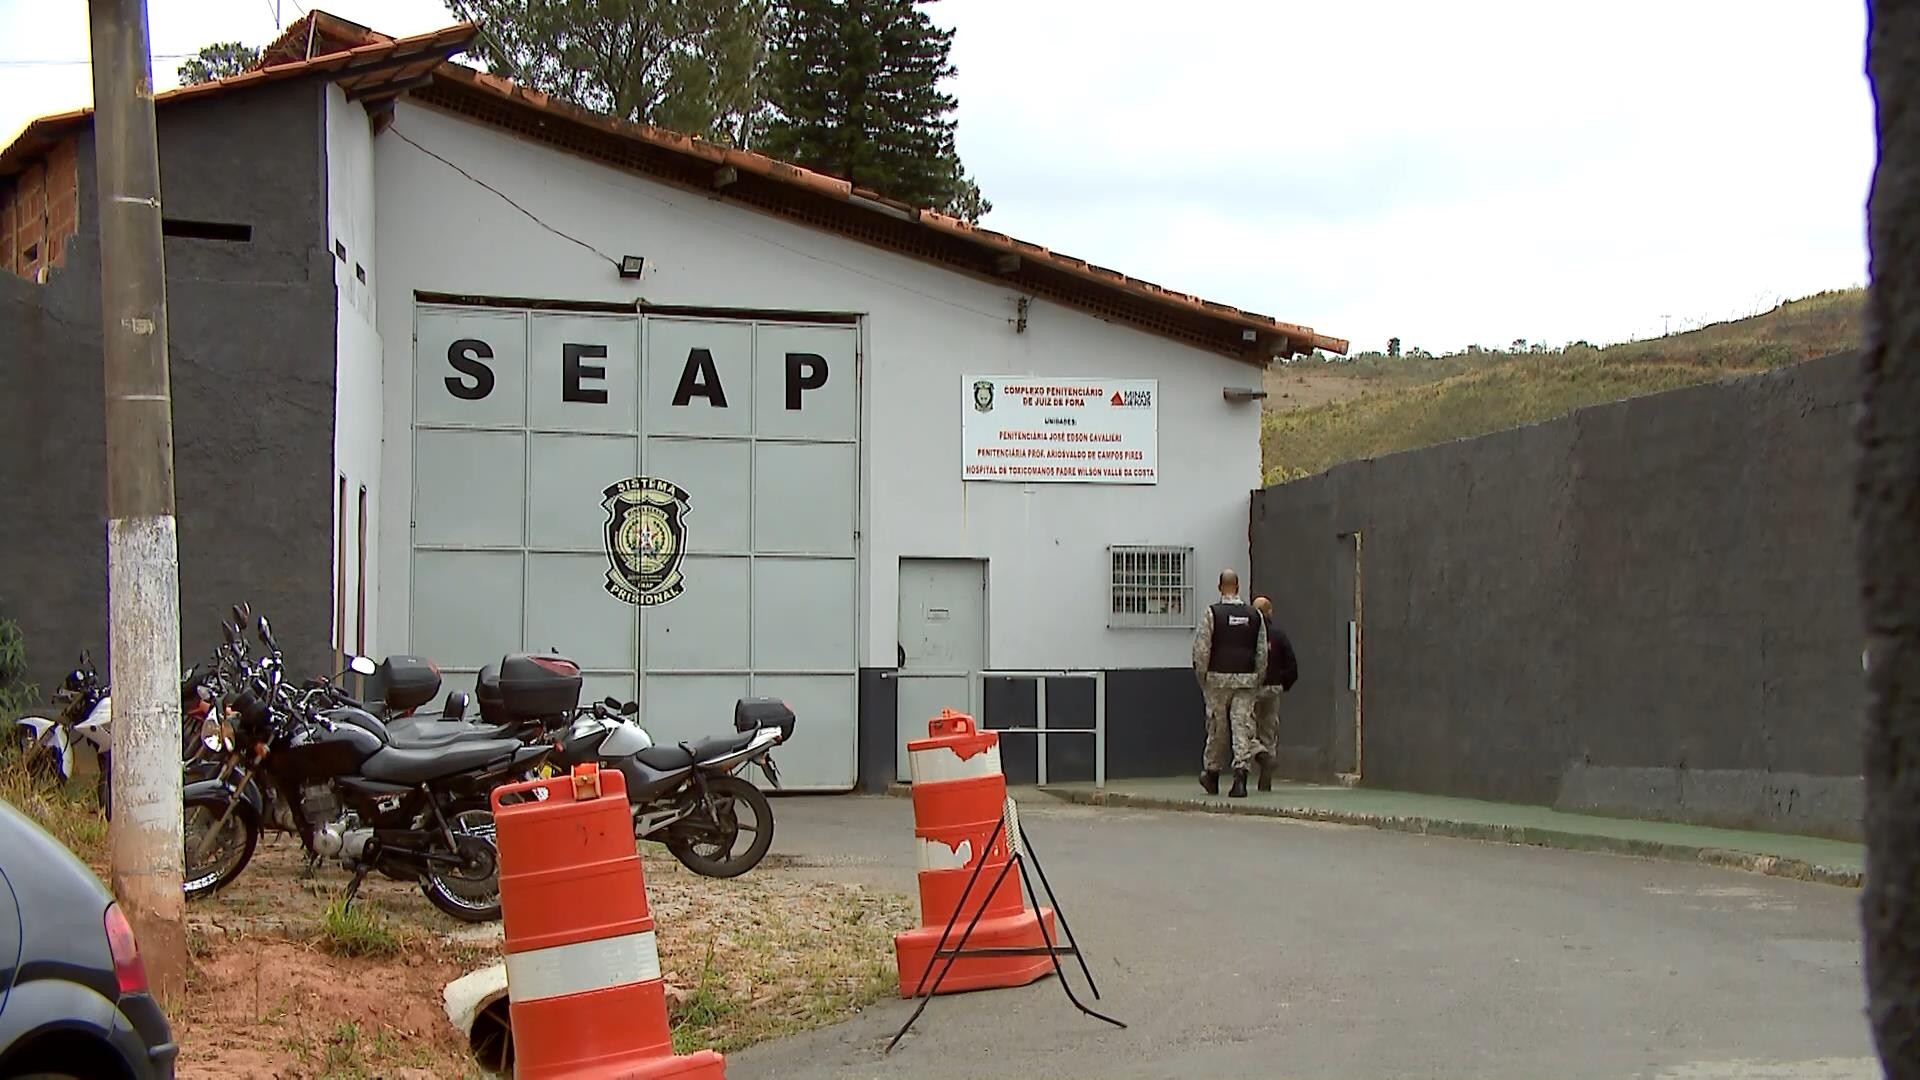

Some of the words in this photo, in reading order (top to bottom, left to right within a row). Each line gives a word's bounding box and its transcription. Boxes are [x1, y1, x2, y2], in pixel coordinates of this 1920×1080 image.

[444, 339, 829, 411] SEAP
[1004, 386, 1045, 395] COMPLEXO
[1046, 386, 1103, 397] PENITENCIÁRIO
[1124, 390, 1151, 399] MINAS
[1022, 397, 1033, 406] DE
[1034, 397, 1052, 406] JUIZ
[1053, 398, 1063, 407] DE
[1065, 398, 1085, 407] FORA
[999, 431, 1048, 440] PENITENCIÁRIA
[1049, 432, 1065, 441] JOSÉ
[1066, 433, 1088, 442] EDSON
[977, 448, 1026, 458] PENITENCIÁRIA
[1046, 450, 1086, 459] ARIOSVALDO
[1087, 451, 1096, 459] DE
[1097, 451, 1123, 460] CAMPOS
[1124, 451, 1143, 460] PIRES
[966, 465, 998, 474] HOSPITAL
[998, 466, 1007, 474] DE
[1055, 467, 1076, 476] PADRE
[1077, 467, 1102, 476] WILSON
[1124, 468, 1133, 476] DA
[1133, 468, 1154, 476] COSTA
[617, 479, 676, 497] SISTEMA
[610, 584, 679, 604] PRISIONAL
